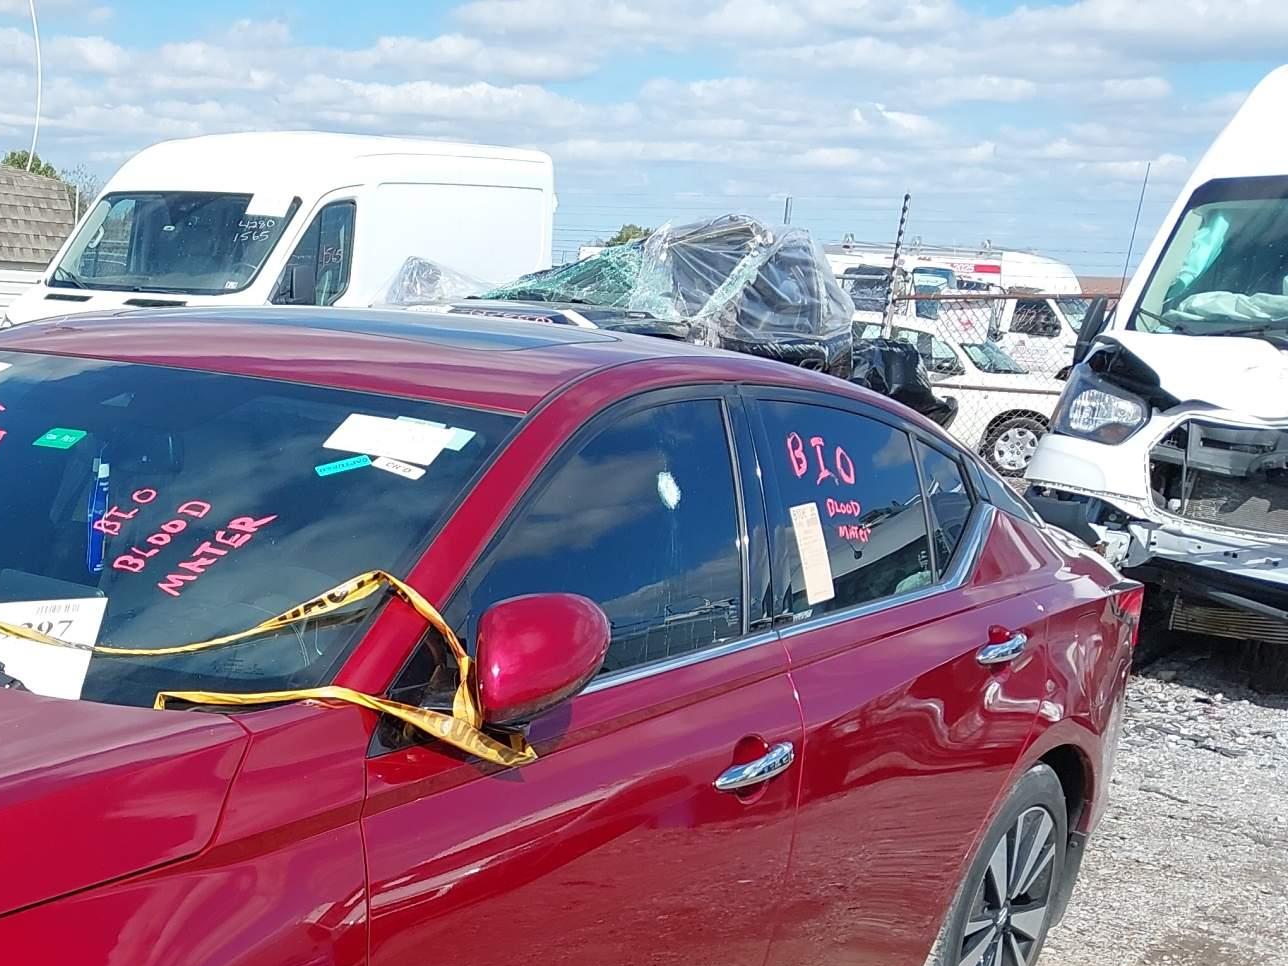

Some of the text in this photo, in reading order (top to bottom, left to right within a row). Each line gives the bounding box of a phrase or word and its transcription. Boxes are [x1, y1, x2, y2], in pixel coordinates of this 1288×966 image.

[233, 230, 270, 242] 1565
[238, 219, 275, 229] 4280
[787, 431, 855, 486] BIO
[93, 488, 157, 535] BIO
[113, 501, 211, 573] BLOOD
[158, 514, 278, 597] MATER
